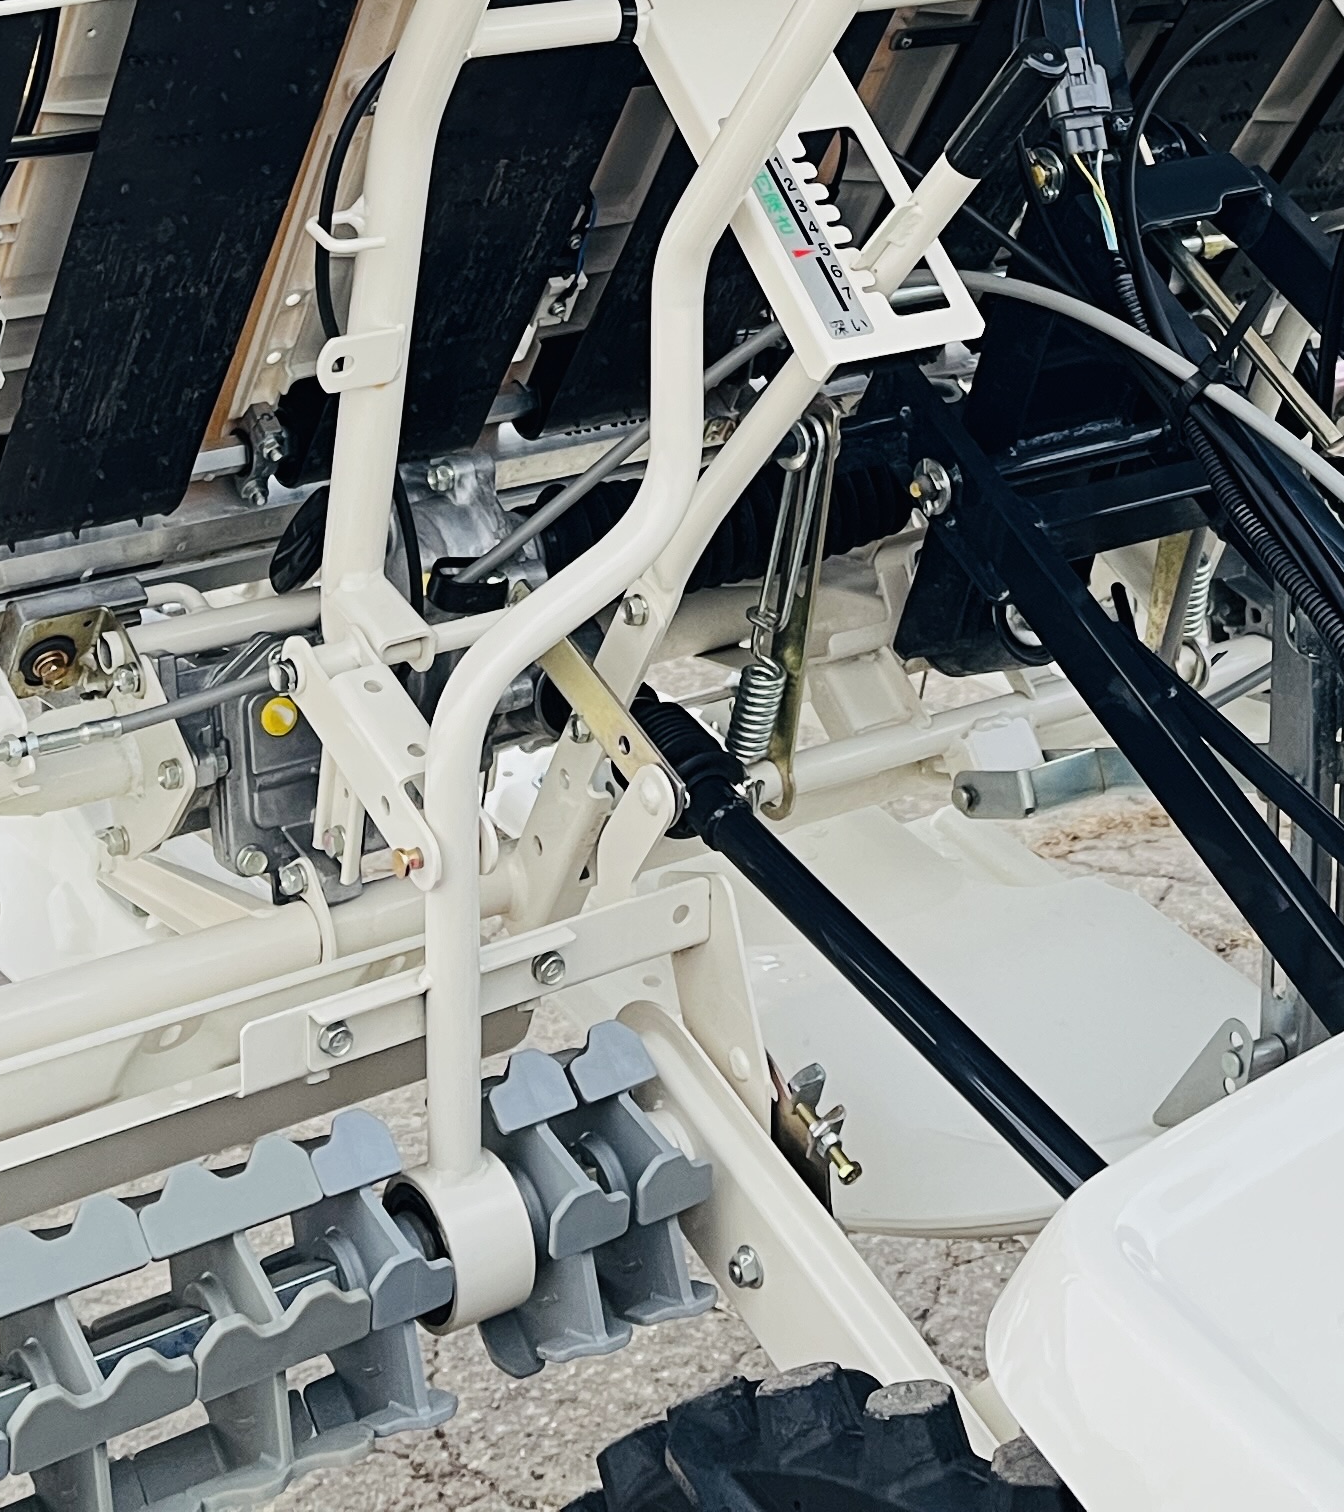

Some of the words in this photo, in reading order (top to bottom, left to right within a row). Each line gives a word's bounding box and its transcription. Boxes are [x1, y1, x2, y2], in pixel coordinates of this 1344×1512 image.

[774, 157, 783, 169] 1
[783, 178, 797, 191] 2
[795, 199, 807, 212] 3
[809, 221, 819, 233] 4
[818, 243, 831, 256] 5
[830, 265, 843, 278] 6
[841, 287, 852, 300] 7
[829, 319, 868, 336] 深い
